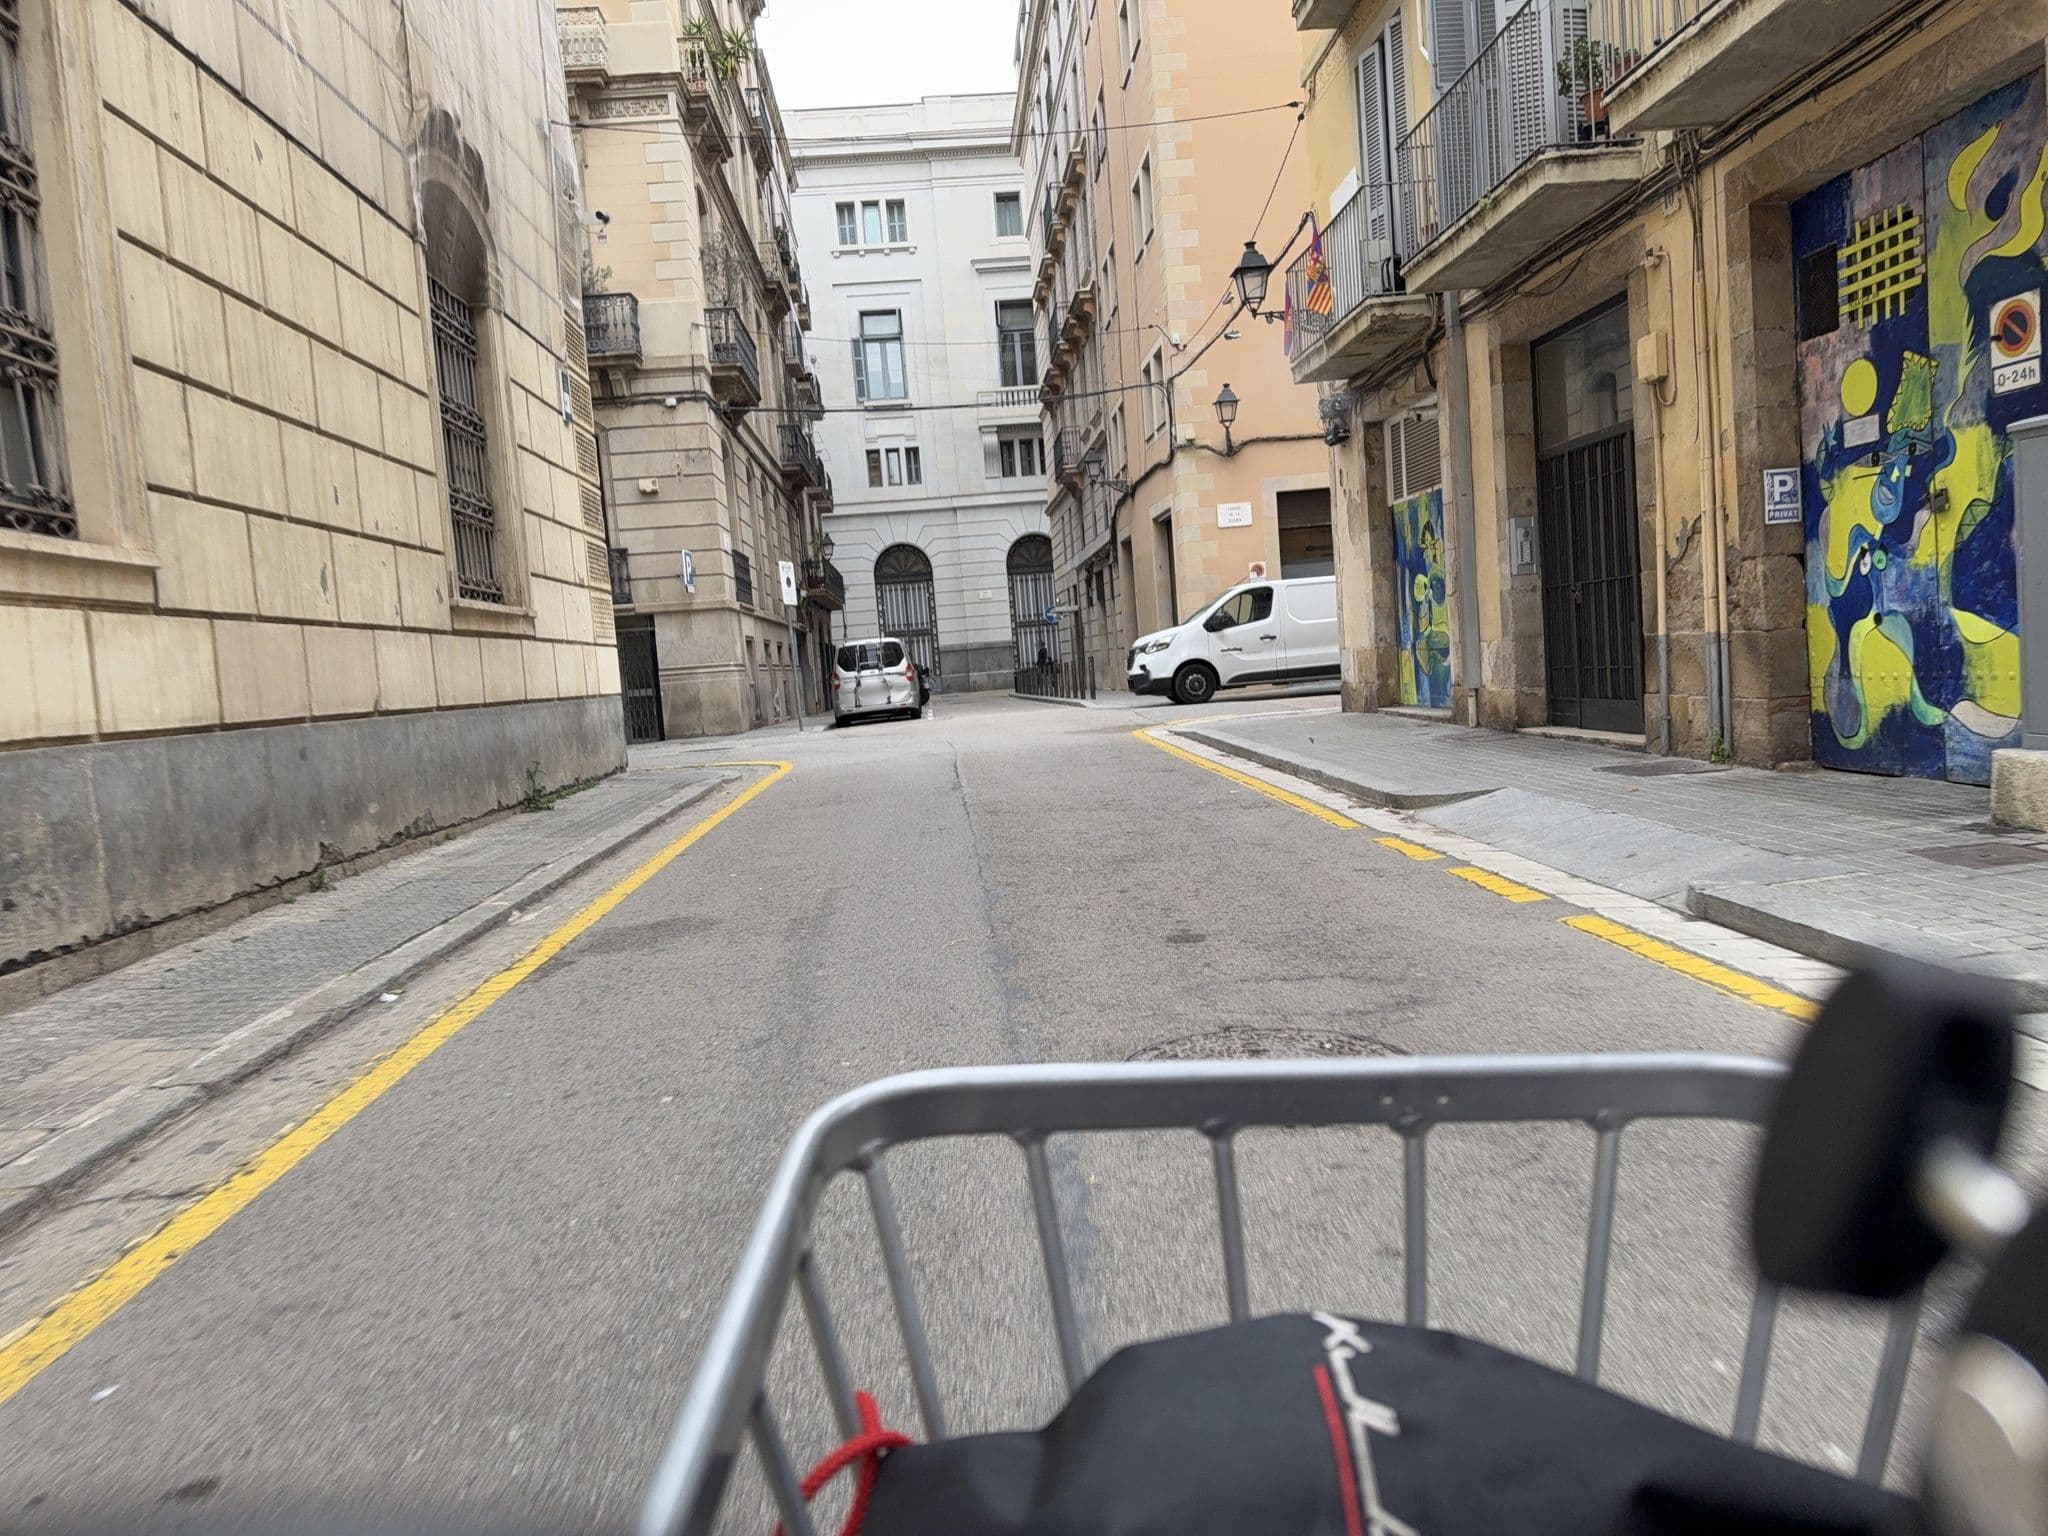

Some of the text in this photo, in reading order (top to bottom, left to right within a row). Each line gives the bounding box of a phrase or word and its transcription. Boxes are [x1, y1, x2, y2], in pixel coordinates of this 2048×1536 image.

[1997, 366, 2036, 387] 0-24h
[1774, 474, 1793, 502] P
[686, 556, 692, 580] P
